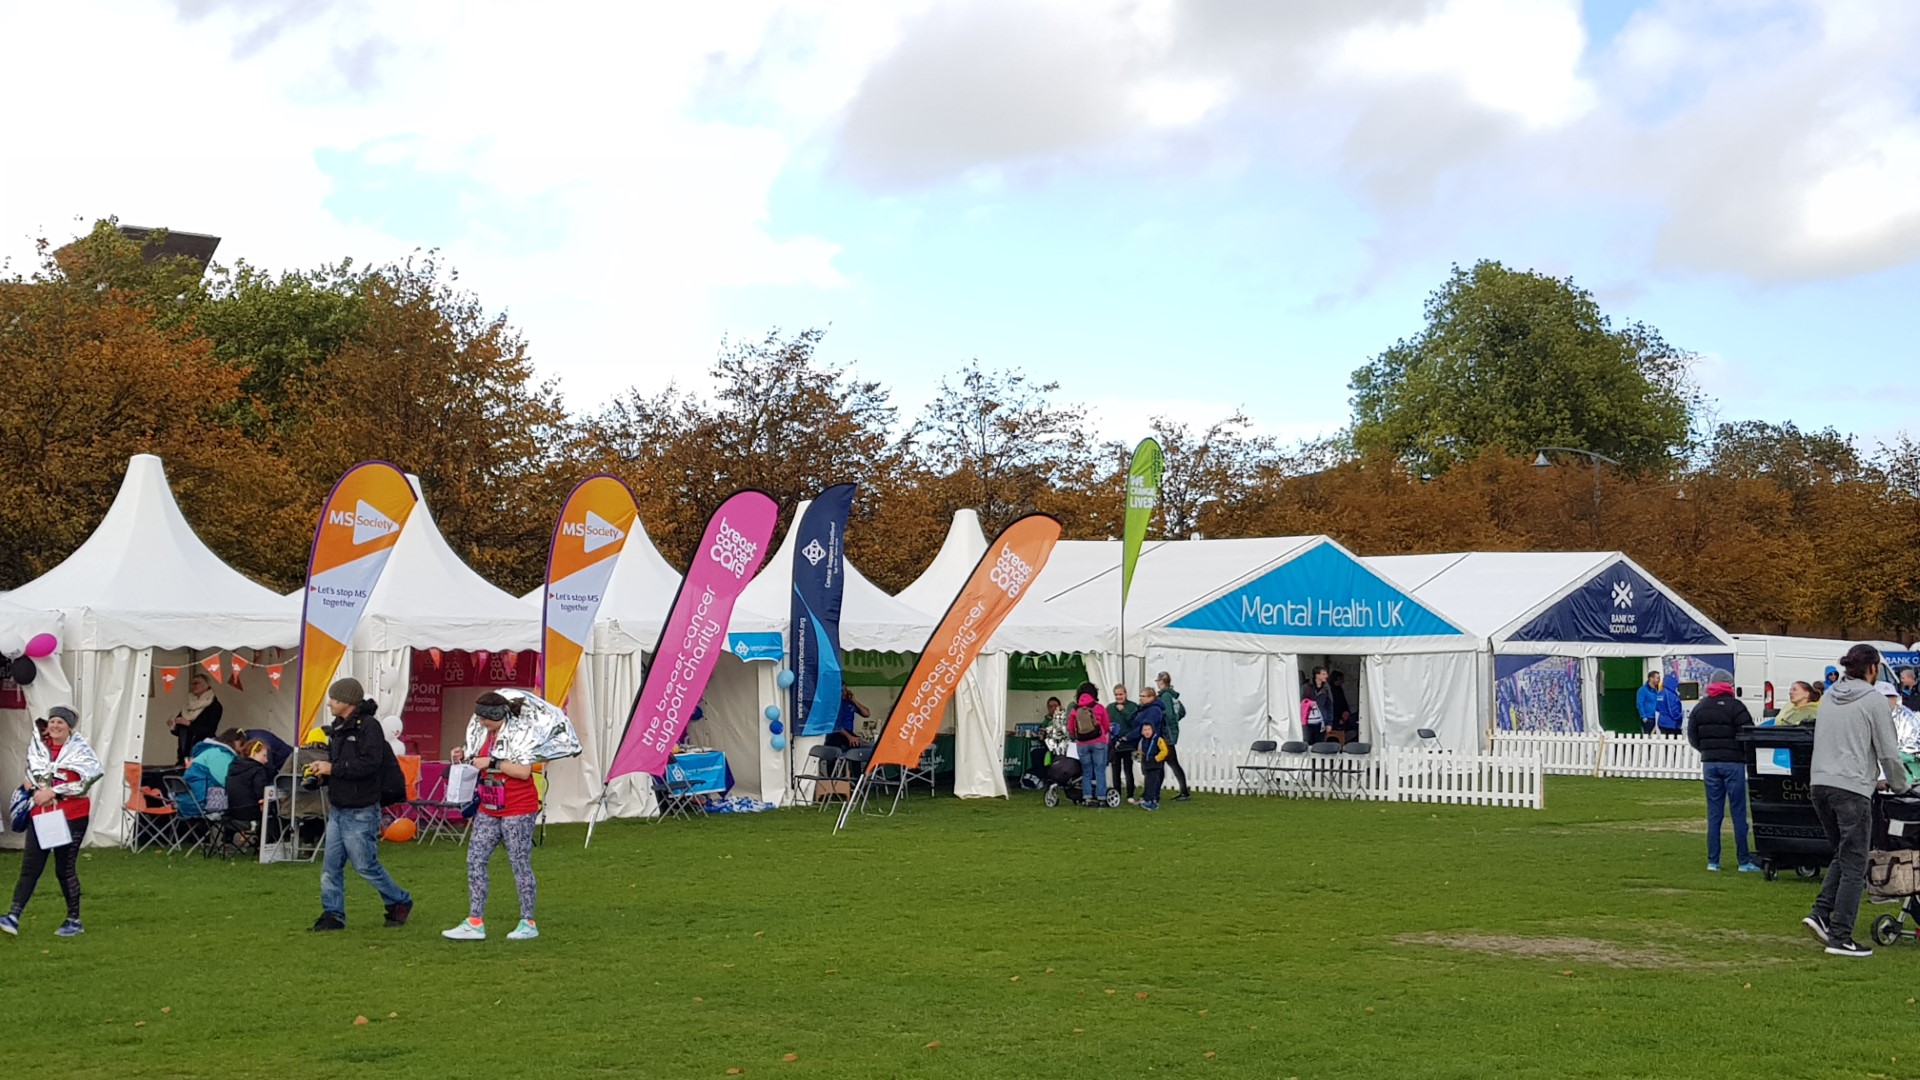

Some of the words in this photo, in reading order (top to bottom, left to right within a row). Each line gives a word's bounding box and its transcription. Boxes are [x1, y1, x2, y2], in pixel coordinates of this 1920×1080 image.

[329, 510, 354, 528] MS
[356, 515, 393, 532] Society
[562, 522, 585, 537] MS
[586, 526, 619, 539] Society
[720, 516, 757, 547] breast
[710, 544, 745, 579] care
[716, 533, 752, 566] cancer
[317, 585, 335, 595] Let's
[336, 588, 353, 598] stop
[354, 590, 367, 598] MS
[990, 566, 1020, 599] care
[323, 598, 356, 608] together
[555, 592, 571, 601] Let's
[571, 594, 587, 603] stop
[560, 603, 588, 612] together
[1241, 594, 1312, 627] Mental
[1317, 598, 1373, 628] Health
[1377, 600, 1405, 628] UK
[1611, 614, 1627, 623] BANK
[1627, 614, 1636, 623] OF
[1609, 624, 1637, 634] SCOTLAND
[641, 715, 660, 747] the
[655, 652, 686, 712] breast
[683, 584, 716, 650] cancer
[945, 629, 977, 684] charity
[1885, 656, 1910, 664] BANK
[899, 712, 915, 740] the
[911, 658, 950, 708] breast
[947, 601, 986, 656] cancer
[656, 683, 688, 754] support
[683, 619, 721, 681] charity
